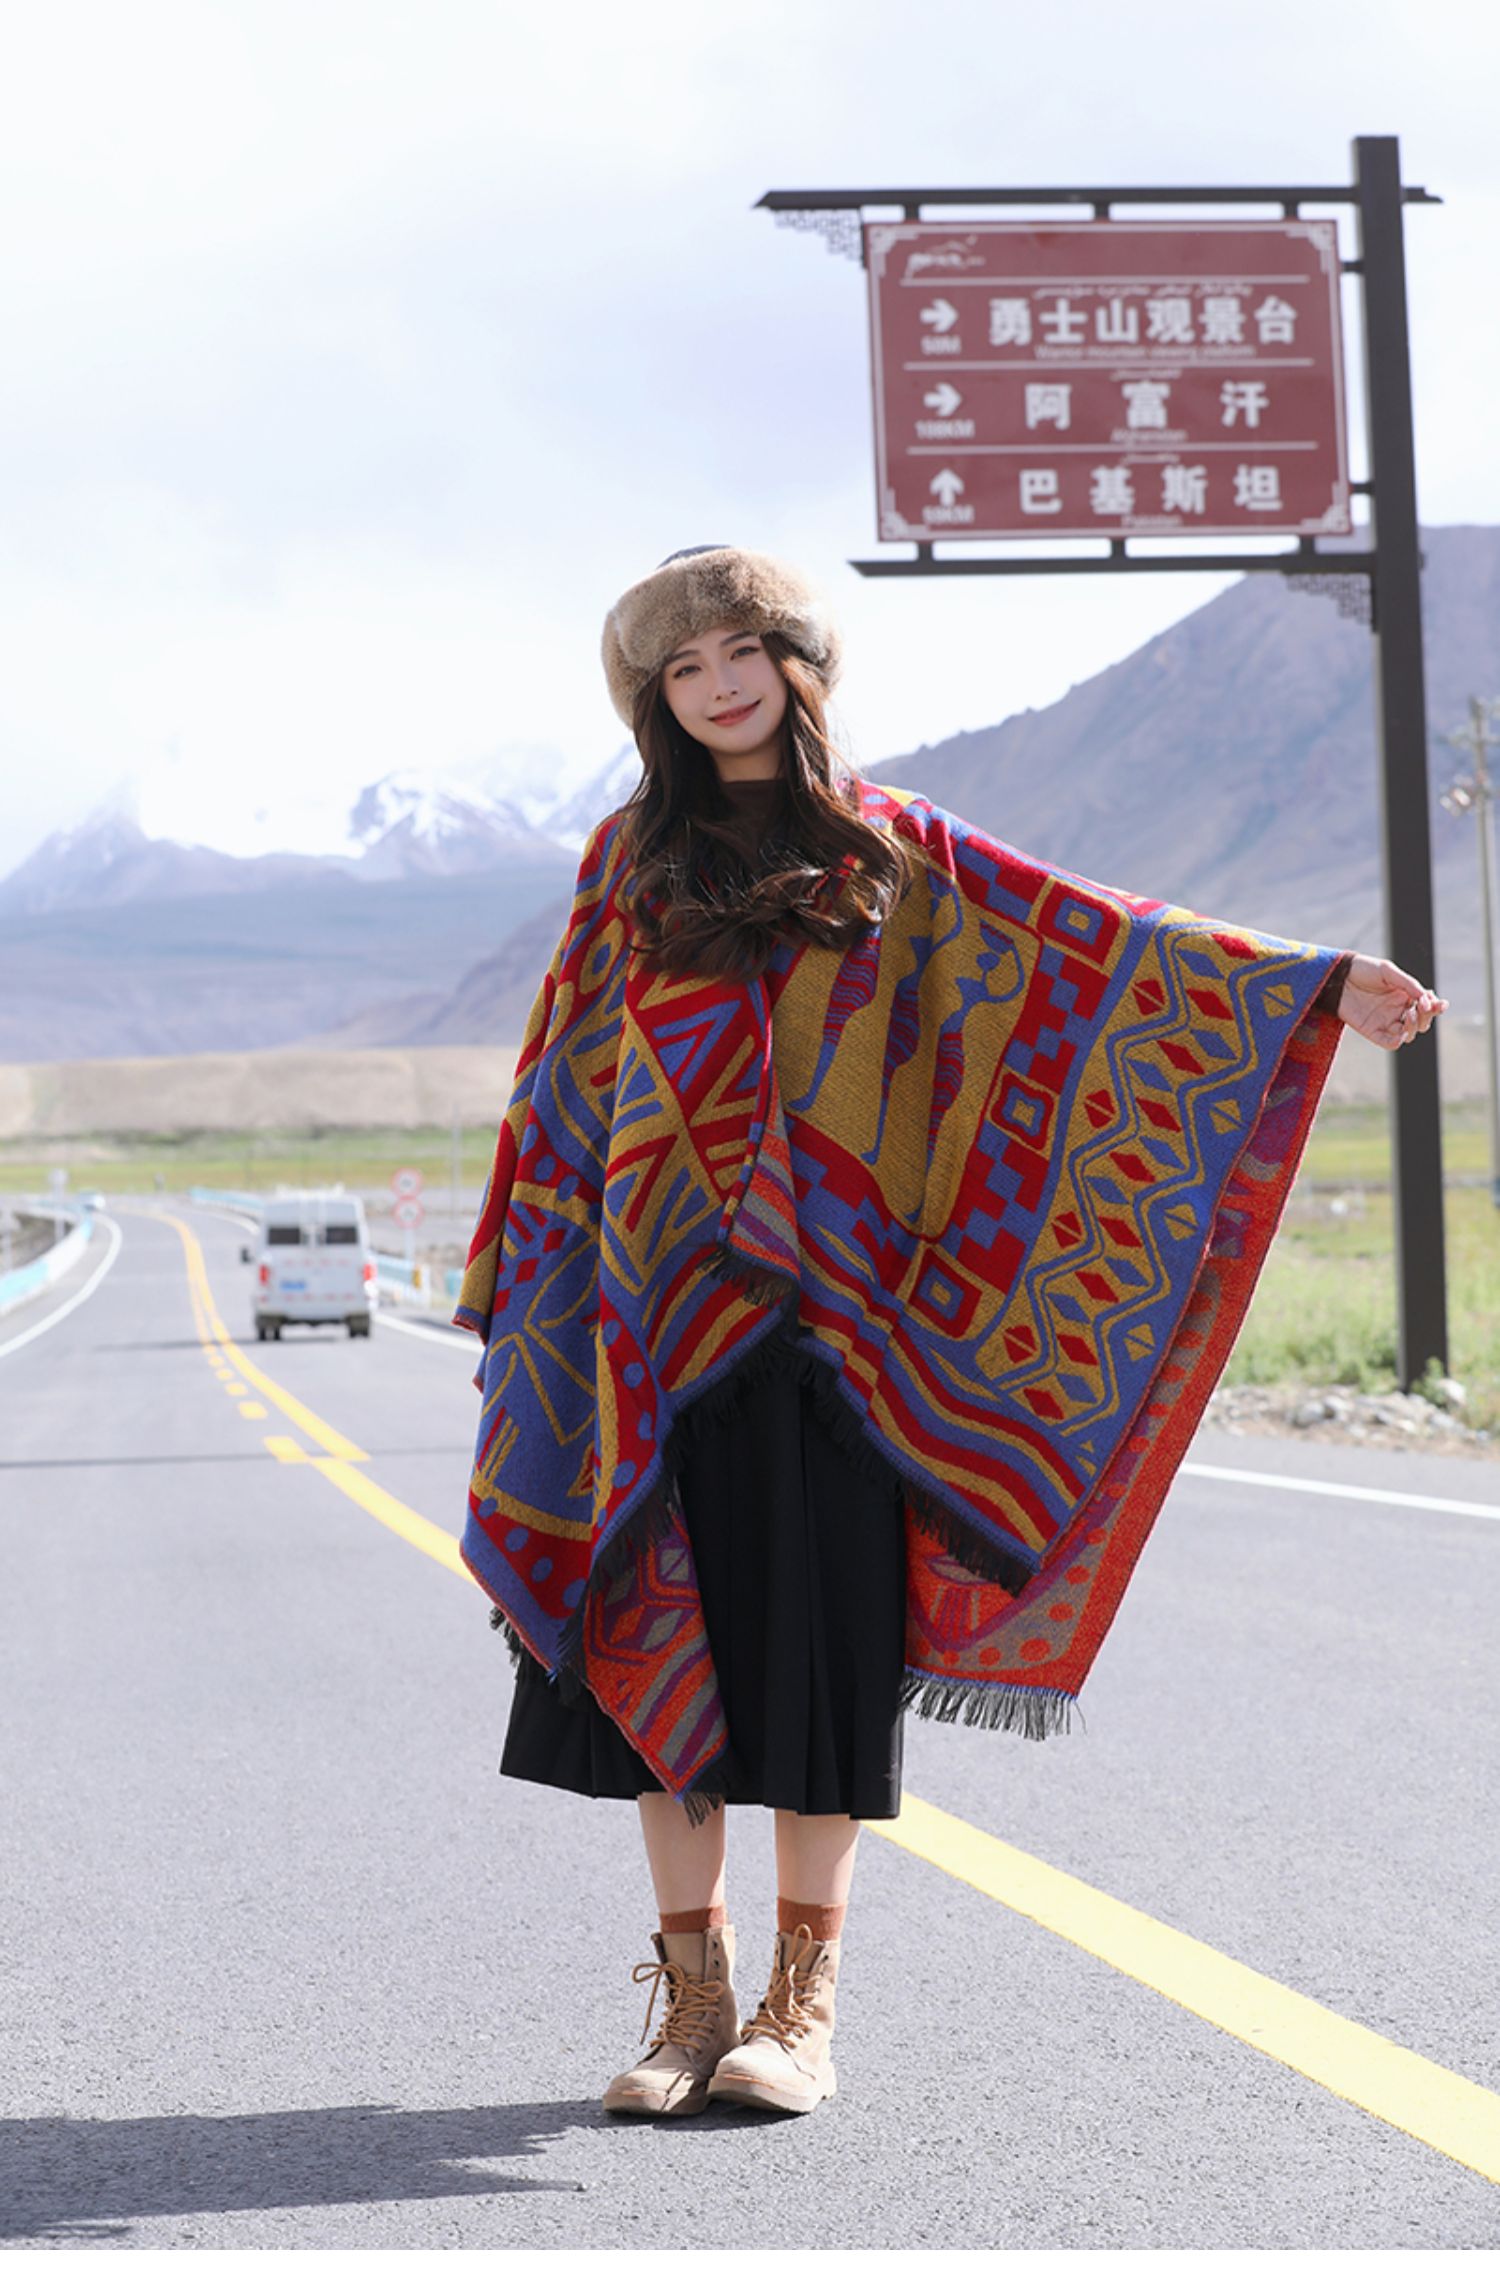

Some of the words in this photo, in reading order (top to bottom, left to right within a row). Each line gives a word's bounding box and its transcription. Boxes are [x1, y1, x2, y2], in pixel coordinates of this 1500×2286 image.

[990, 296, 1297, 346] 勇士山观景台
[1025, 380, 1268, 430] 阿富汗
[1020, 465, 1283, 515] 巴基斯坦
